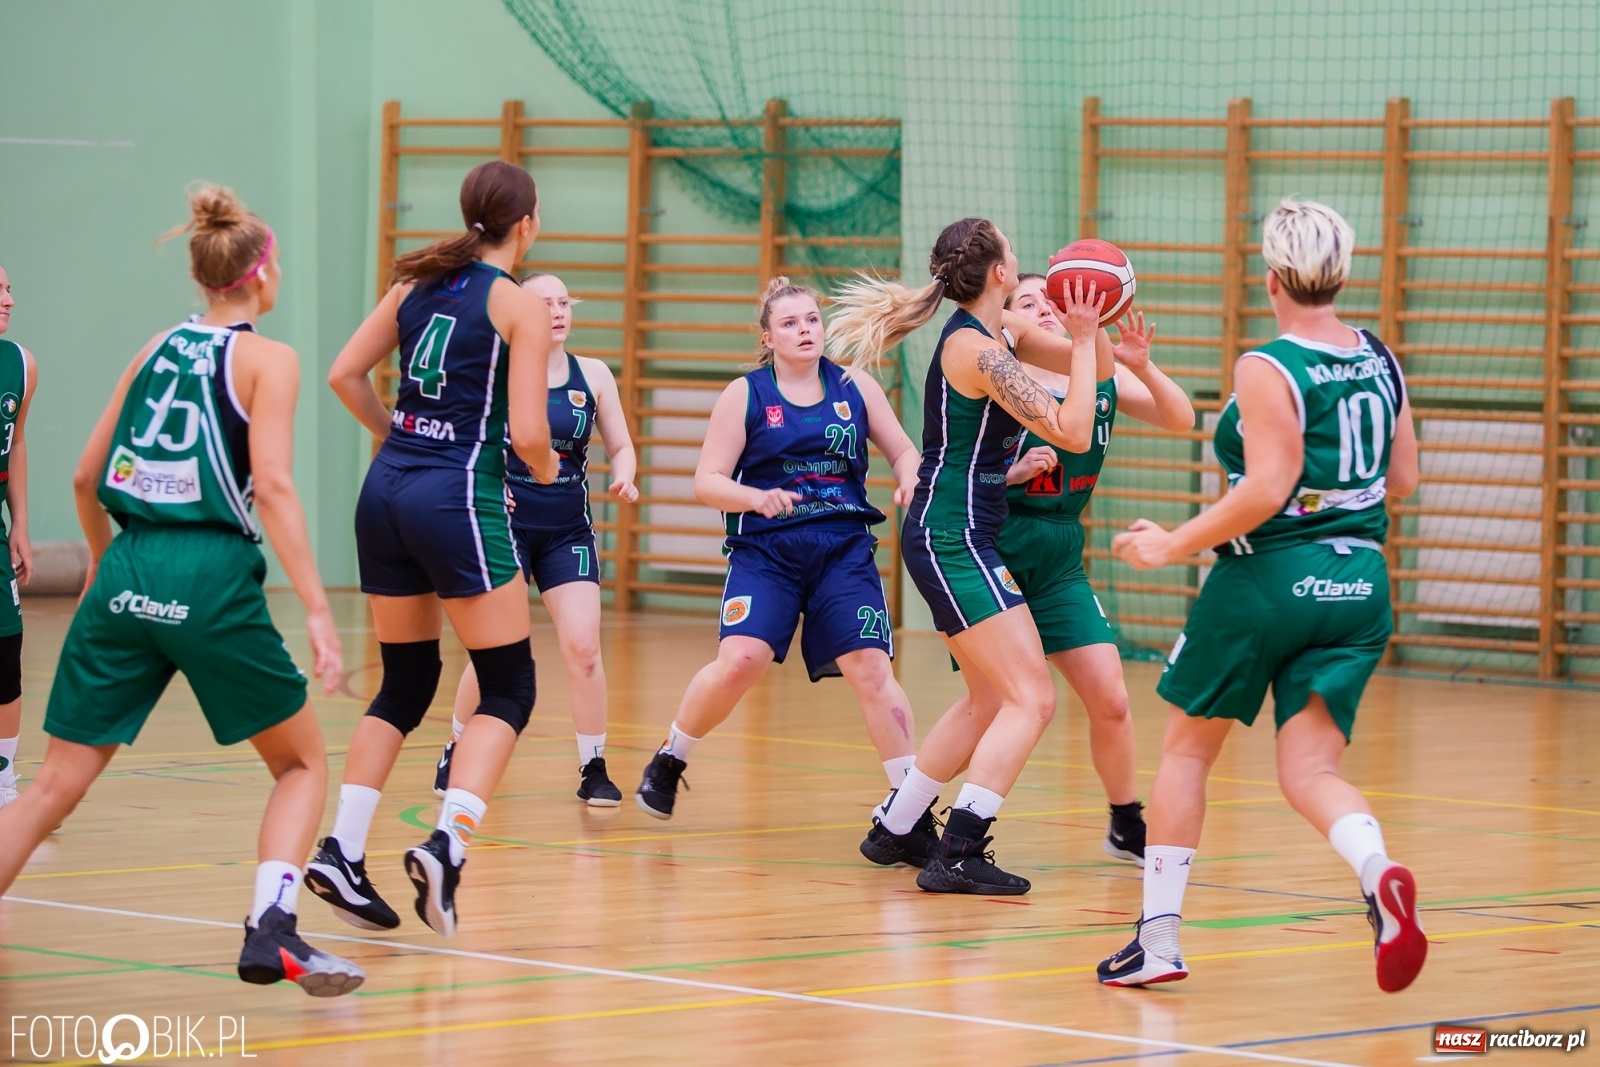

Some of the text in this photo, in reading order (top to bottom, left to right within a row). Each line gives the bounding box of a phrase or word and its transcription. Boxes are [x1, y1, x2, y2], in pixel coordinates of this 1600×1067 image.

[409, 313, 457, 400] 4
[130, 355, 200, 452] 35
[572, 408, 587, 438] 7
[824, 423, 857, 459] 21
[1337, 391, 1385, 482] 10
[572, 546, 590, 576] 7
[1312, 578, 1374, 596] Clavis
[128, 594, 190, 620] Clavis
[857, 605, 889, 643] 21
